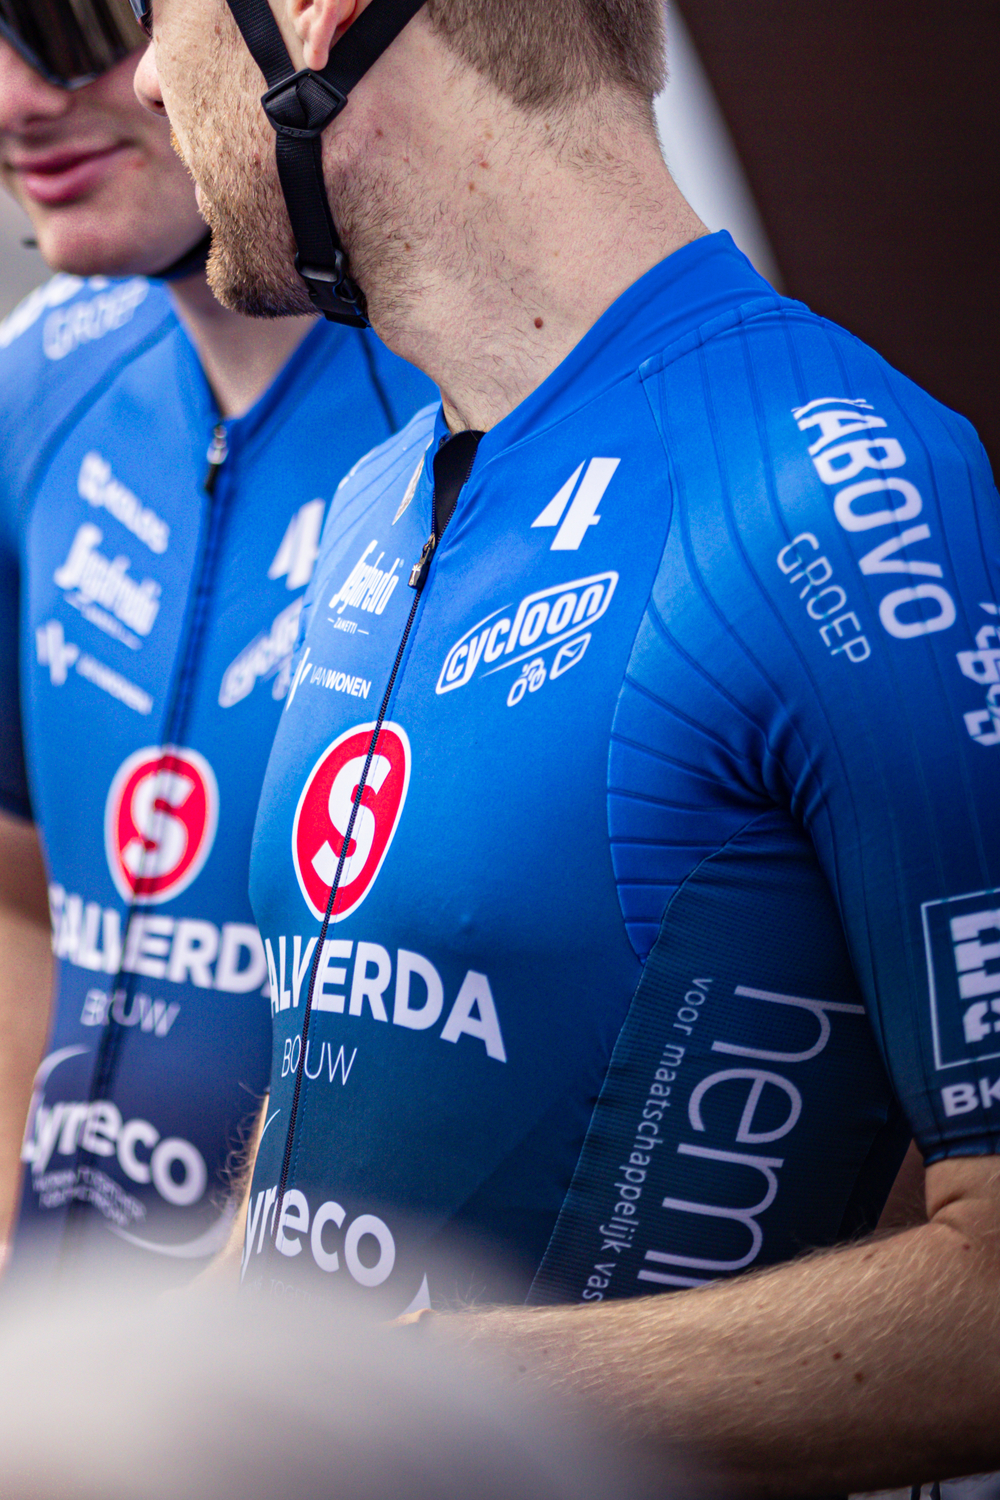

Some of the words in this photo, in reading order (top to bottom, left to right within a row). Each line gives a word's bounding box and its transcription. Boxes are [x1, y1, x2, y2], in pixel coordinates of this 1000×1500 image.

[530, 457, 622, 551] 4
[445, 583, 605, 682] cycloon
[777, 532, 871, 663] GROEP
[119, 770, 196, 879] S
[311, 753, 392, 888] S
[673, 977, 713, 1037] voor
[281, 1034, 357, 1086] BOUW
[599, 1043, 685, 1254] maatschappelijk
